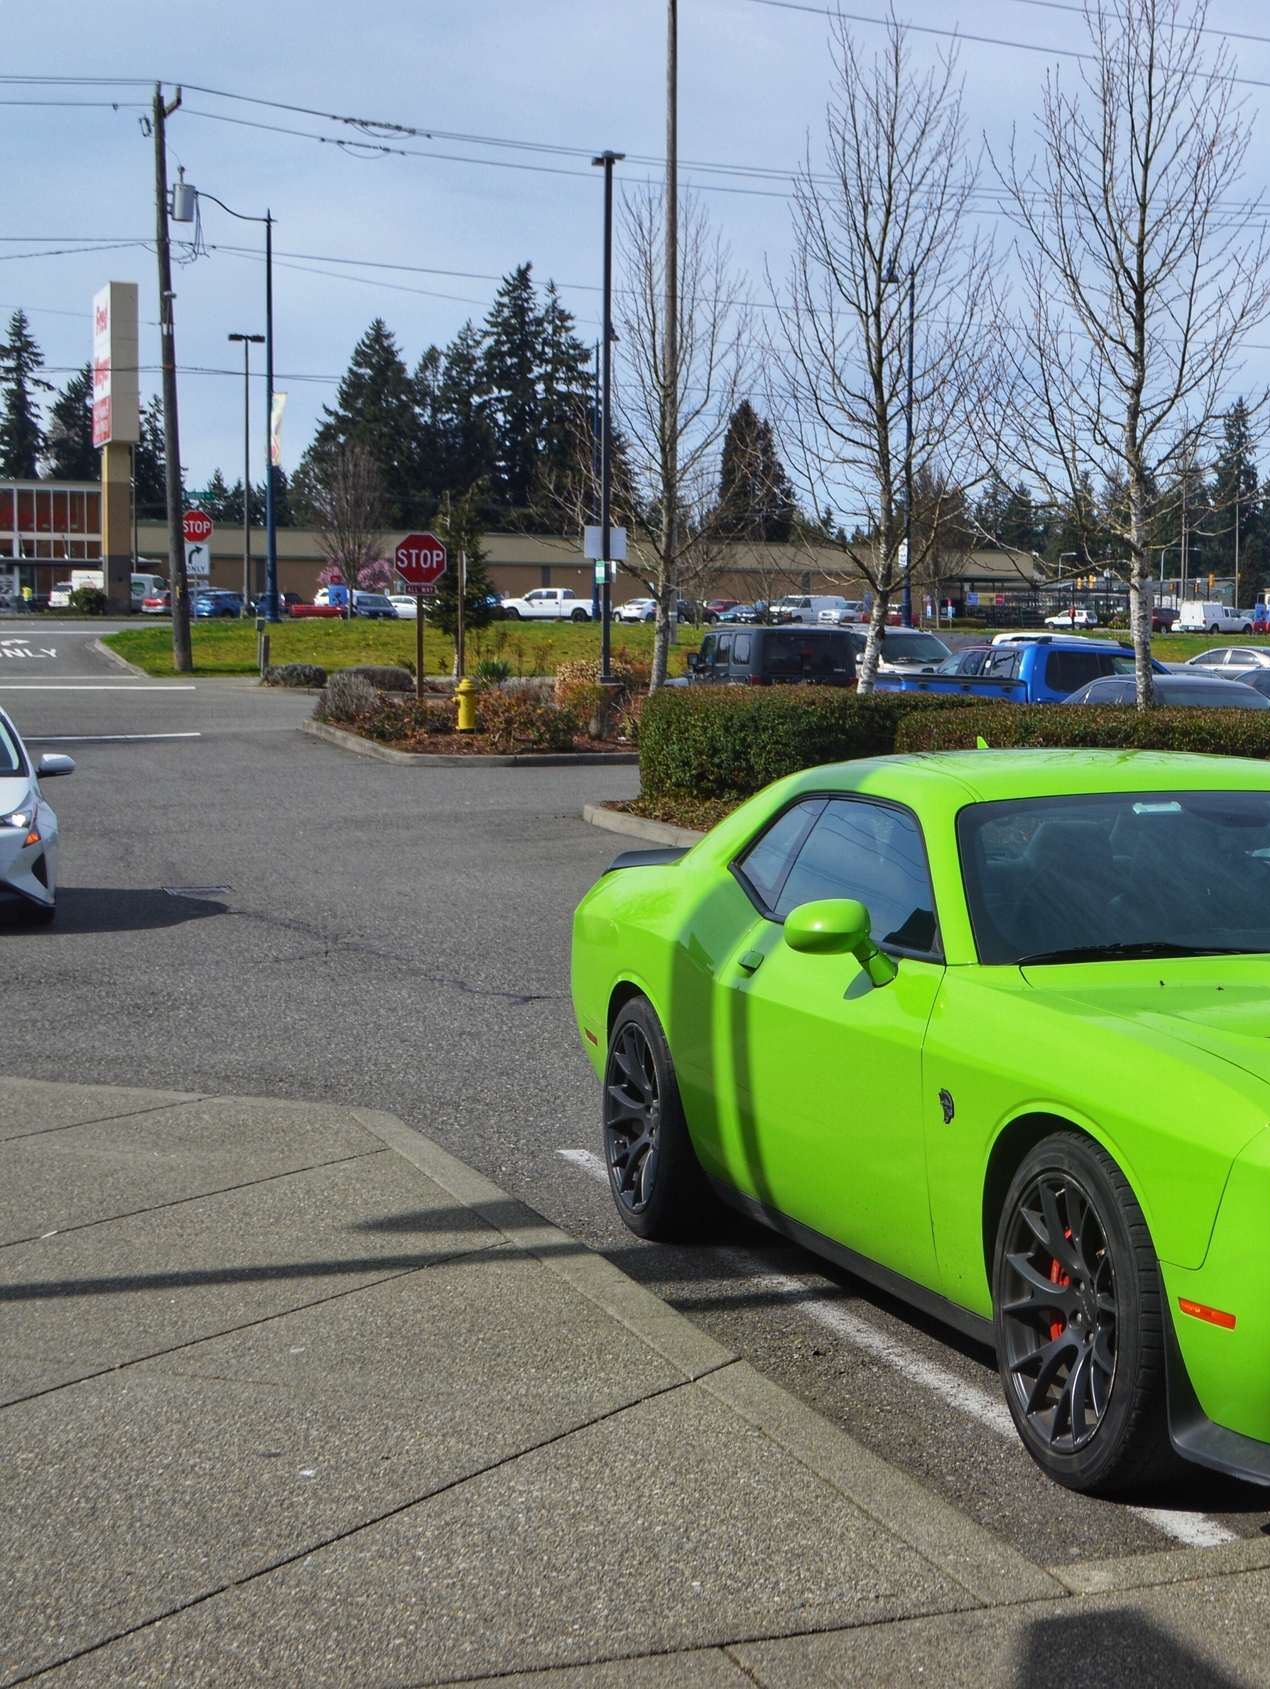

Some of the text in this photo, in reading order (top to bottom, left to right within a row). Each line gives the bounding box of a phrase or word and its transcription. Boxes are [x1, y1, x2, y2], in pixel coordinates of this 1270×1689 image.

[183, 521, 210, 533] STOP
[397, 549, 443, 568] STOP
[0, 648, 57, 658] NLY
